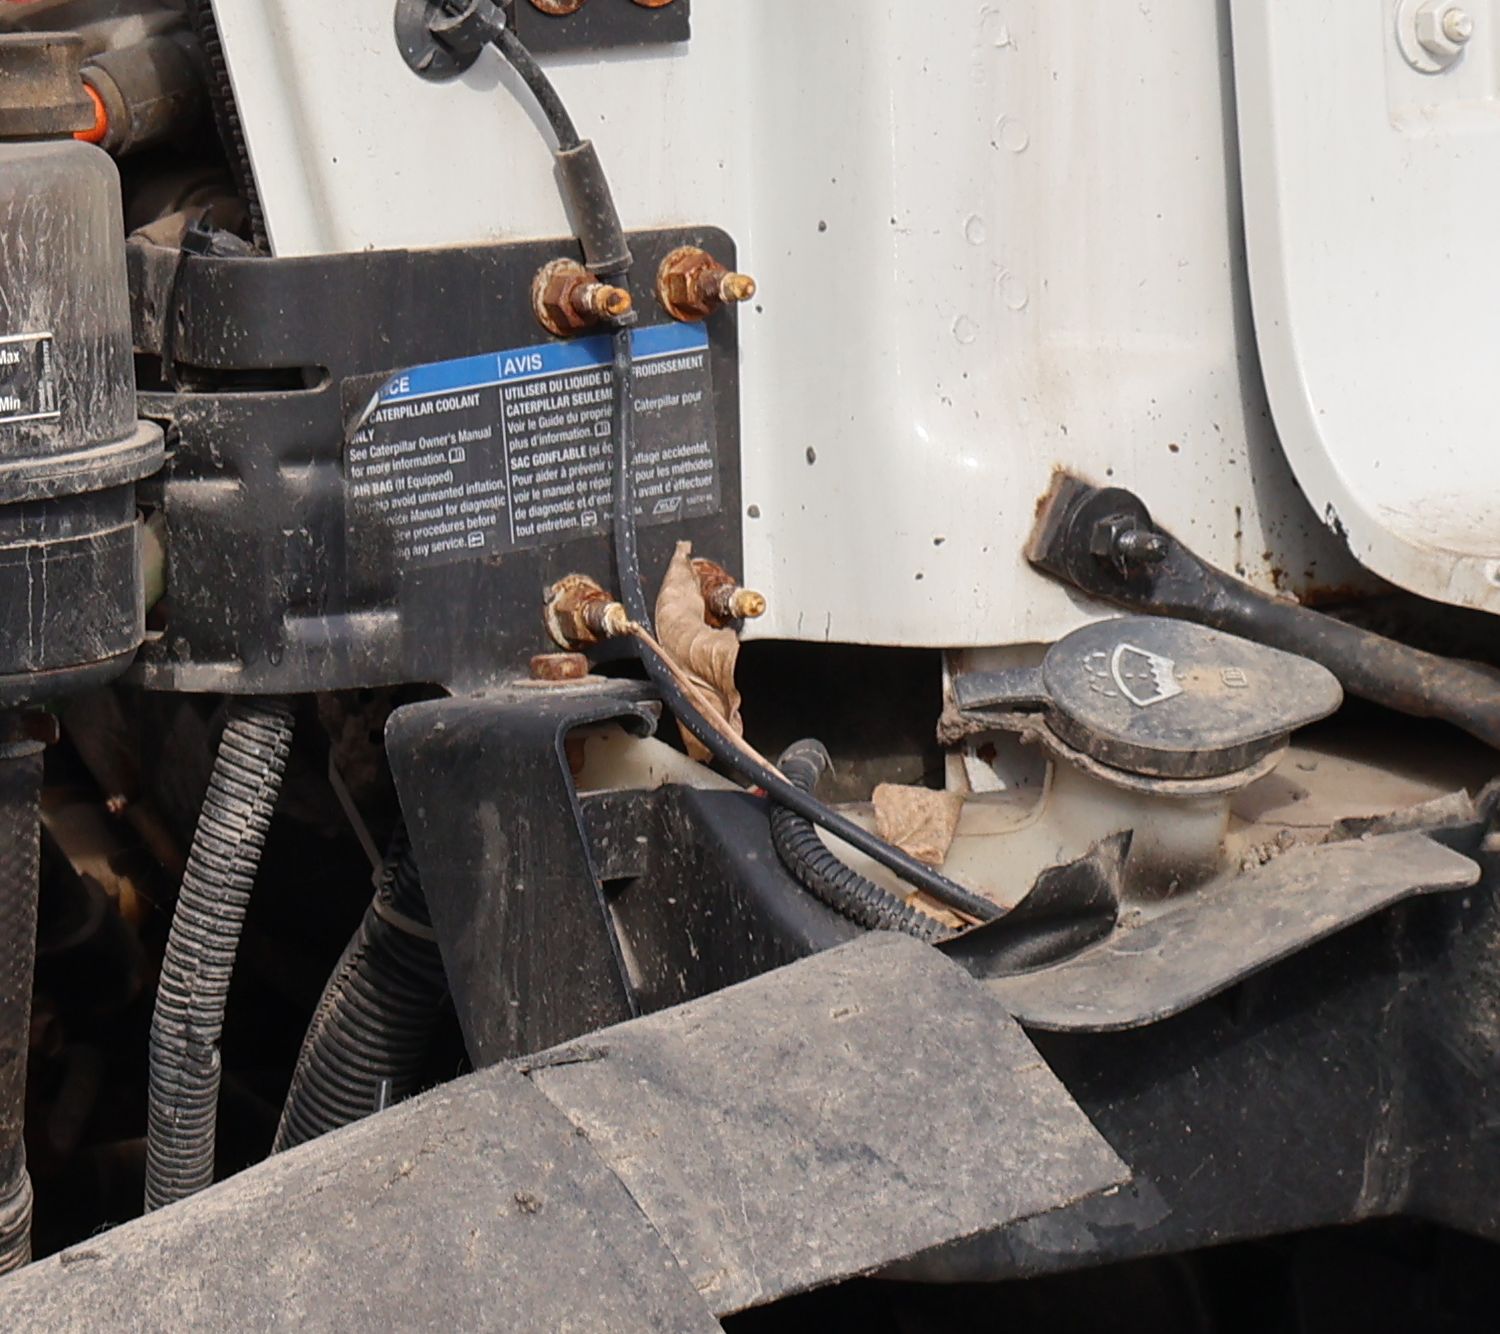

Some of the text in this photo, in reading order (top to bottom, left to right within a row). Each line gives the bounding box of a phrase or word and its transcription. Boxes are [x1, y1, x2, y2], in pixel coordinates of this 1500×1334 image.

[504, 353, 542, 376] AVIS
[504, 382, 548, 401] UTILISER
[548, 379, 563, 393] DU
[564, 372, 601, 391] LIQUIDE
[369, 393, 480, 423] CATERPILLAR COOLANT
[506, 394, 570, 418] CATERPILLAR
[507, 390, 702, 434] Voir le Guide du proprié Caterpillar pour
[349, 425, 492, 462] See Caterpillar Owner's Manual
[508, 427, 593, 454] plus d'information.
[350, 452, 448, 479] for more information.
[510, 455, 531, 471] SAC
[532, 445, 587, 467] GONFLABLE
[511, 473, 534, 488] Pour
[535, 468, 558, 484] aider
[568, 459, 606, 480] prévenir
[661, 440, 711, 461] accidentel,
[353, 483, 371, 498] AIR
[371, 479, 394, 495] BAG
[406, 469, 454, 490] Equipped)
[391, 492, 417, 509] avoid
[418, 484, 465, 504] unwanted
[465, 479, 506, 496] inflation,
[513, 489, 530, 504] voir
[531, 488, 541, 500] le
[542, 481, 575, 499] manuel
[576, 479, 588, 494] de
[635, 468, 655, 484] pour
[656, 465, 670, 478] les
[671, 458, 714, 475] méthodes
[410, 505, 444, 522] Manual
[445, 503, 458, 516] for
[459, 495, 506, 514] diagnostic
[514, 507, 527, 521] de
[528, 499, 575, 519] diagnostic
[576, 496, 587, 510] et
[638, 482, 664, 498] avant
[412, 519, 466, 541] procedures
[466, 514, 497, 529] before
[515, 516, 580, 537] tout entretien.
[412, 543, 430, 557] any
[431, 537, 467, 553] service.
